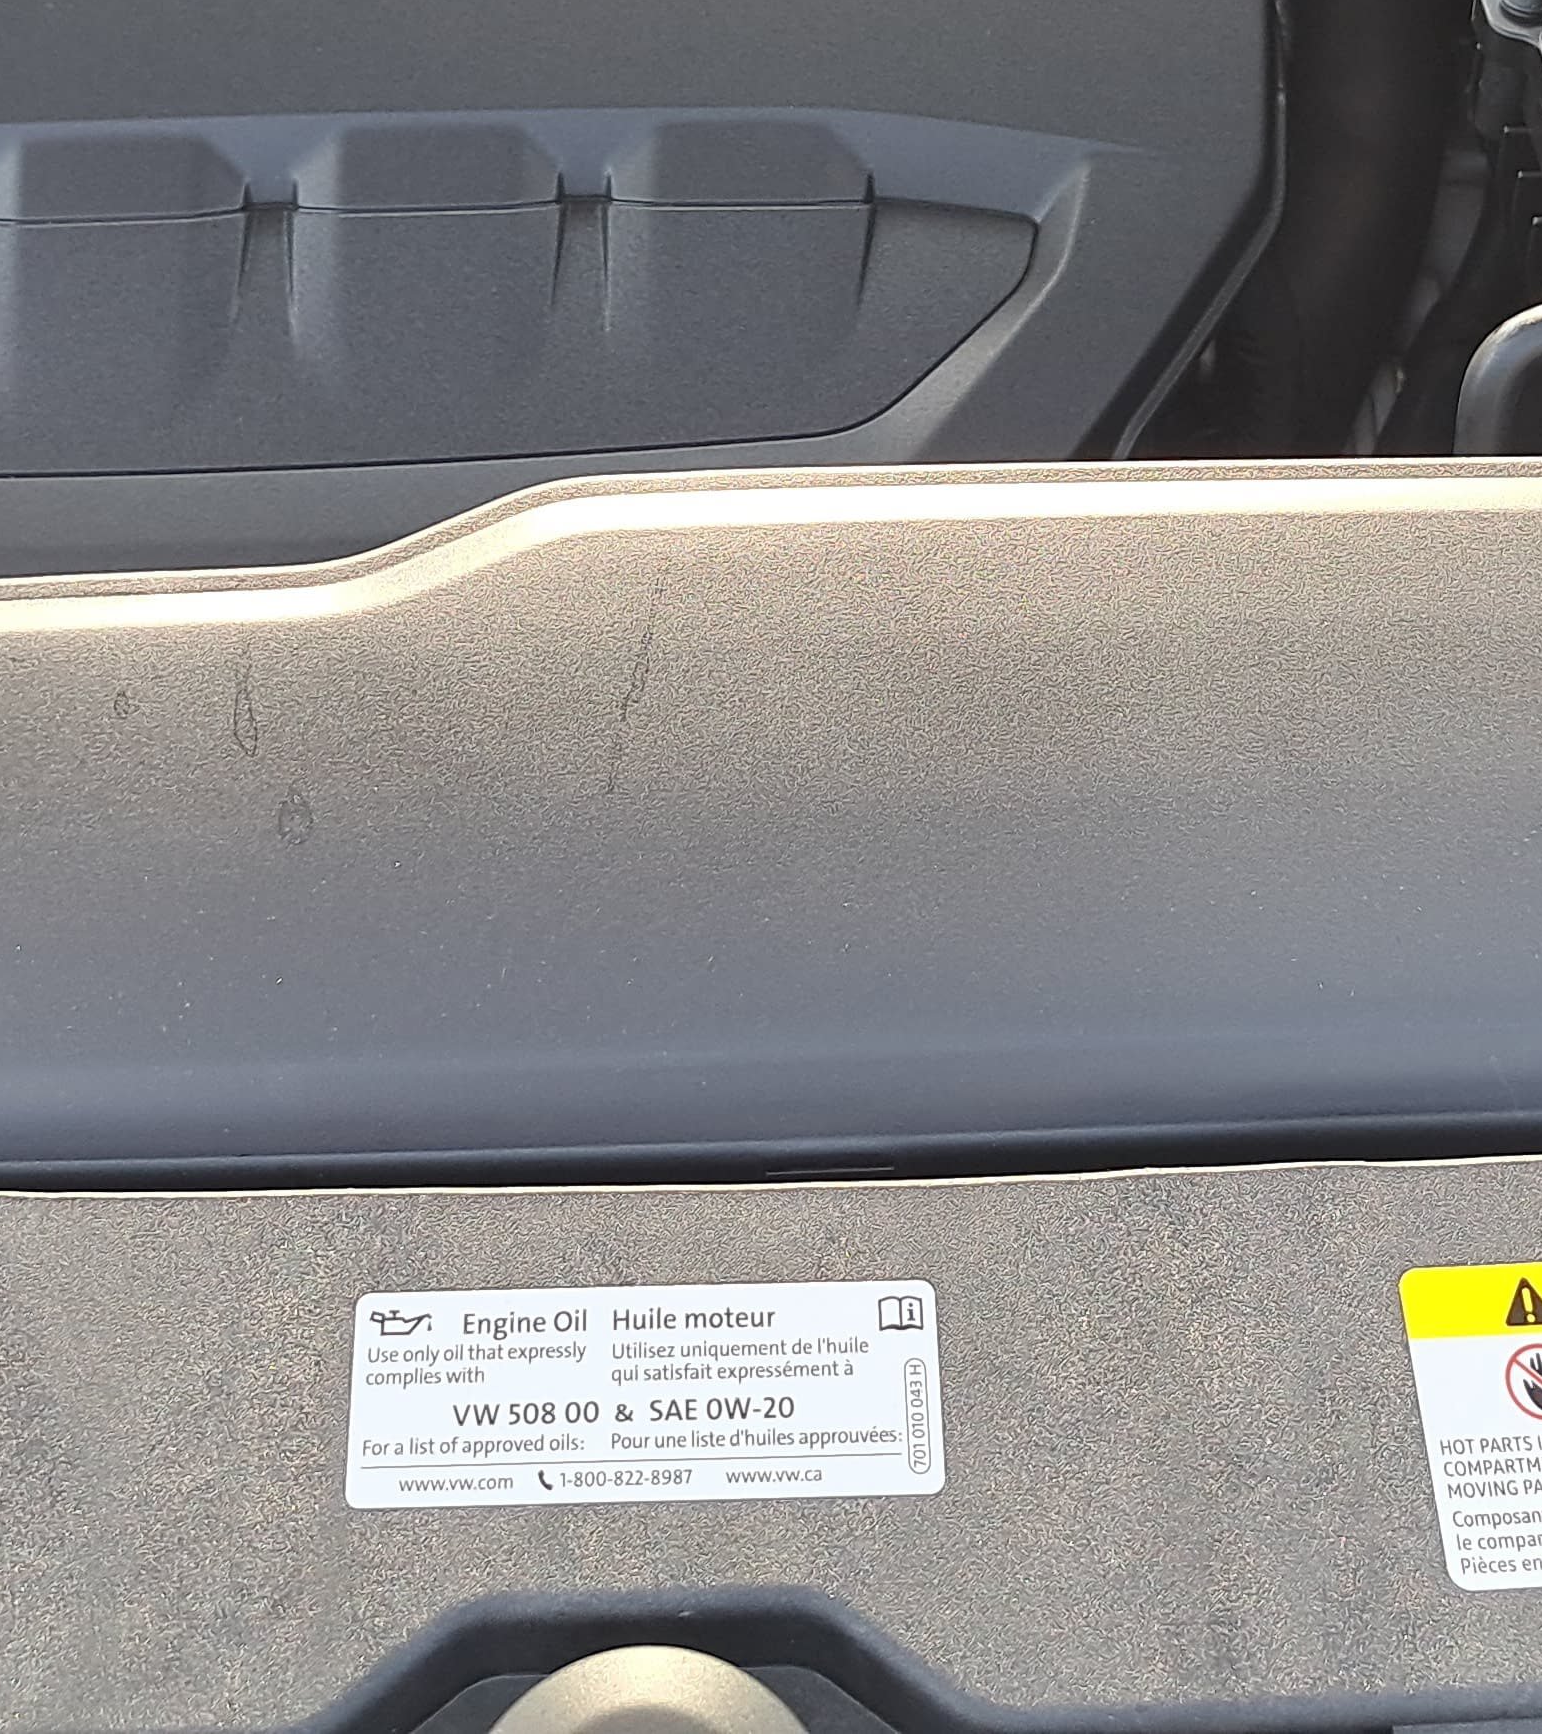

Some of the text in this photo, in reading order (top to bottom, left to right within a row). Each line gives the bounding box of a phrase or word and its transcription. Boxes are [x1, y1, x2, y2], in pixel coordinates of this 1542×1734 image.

[464, 1309, 586, 1340] Engine Oil
[614, 1307, 775, 1330] Huile moteur
[368, 1341, 586, 1367] Use only oil that expressly
[613, 1336, 868, 1361] Utilisez uniquement de l'huile
[366, 1366, 484, 1389] complies with
[612, 1359, 853, 1386] qui satisfait expressément à
[453, 1397, 794, 1426] VW 508 00 & SAE 0W-20
[363, 1433, 584, 1458] For a list of approved oils:
[612, 1426, 902, 1449] Pour une liste d'huiles approuvées:
[1440, 1439, 1474, 1455] HOT
[1480, 1436, 1532, 1453] PARTS
[399, 1469, 822, 1491] www.vw.com 1-800-822-8987 www.vw.ca
[1448, 1480, 1518, 1498] MOVING
[1457, 1534, 1472, 1550] le
